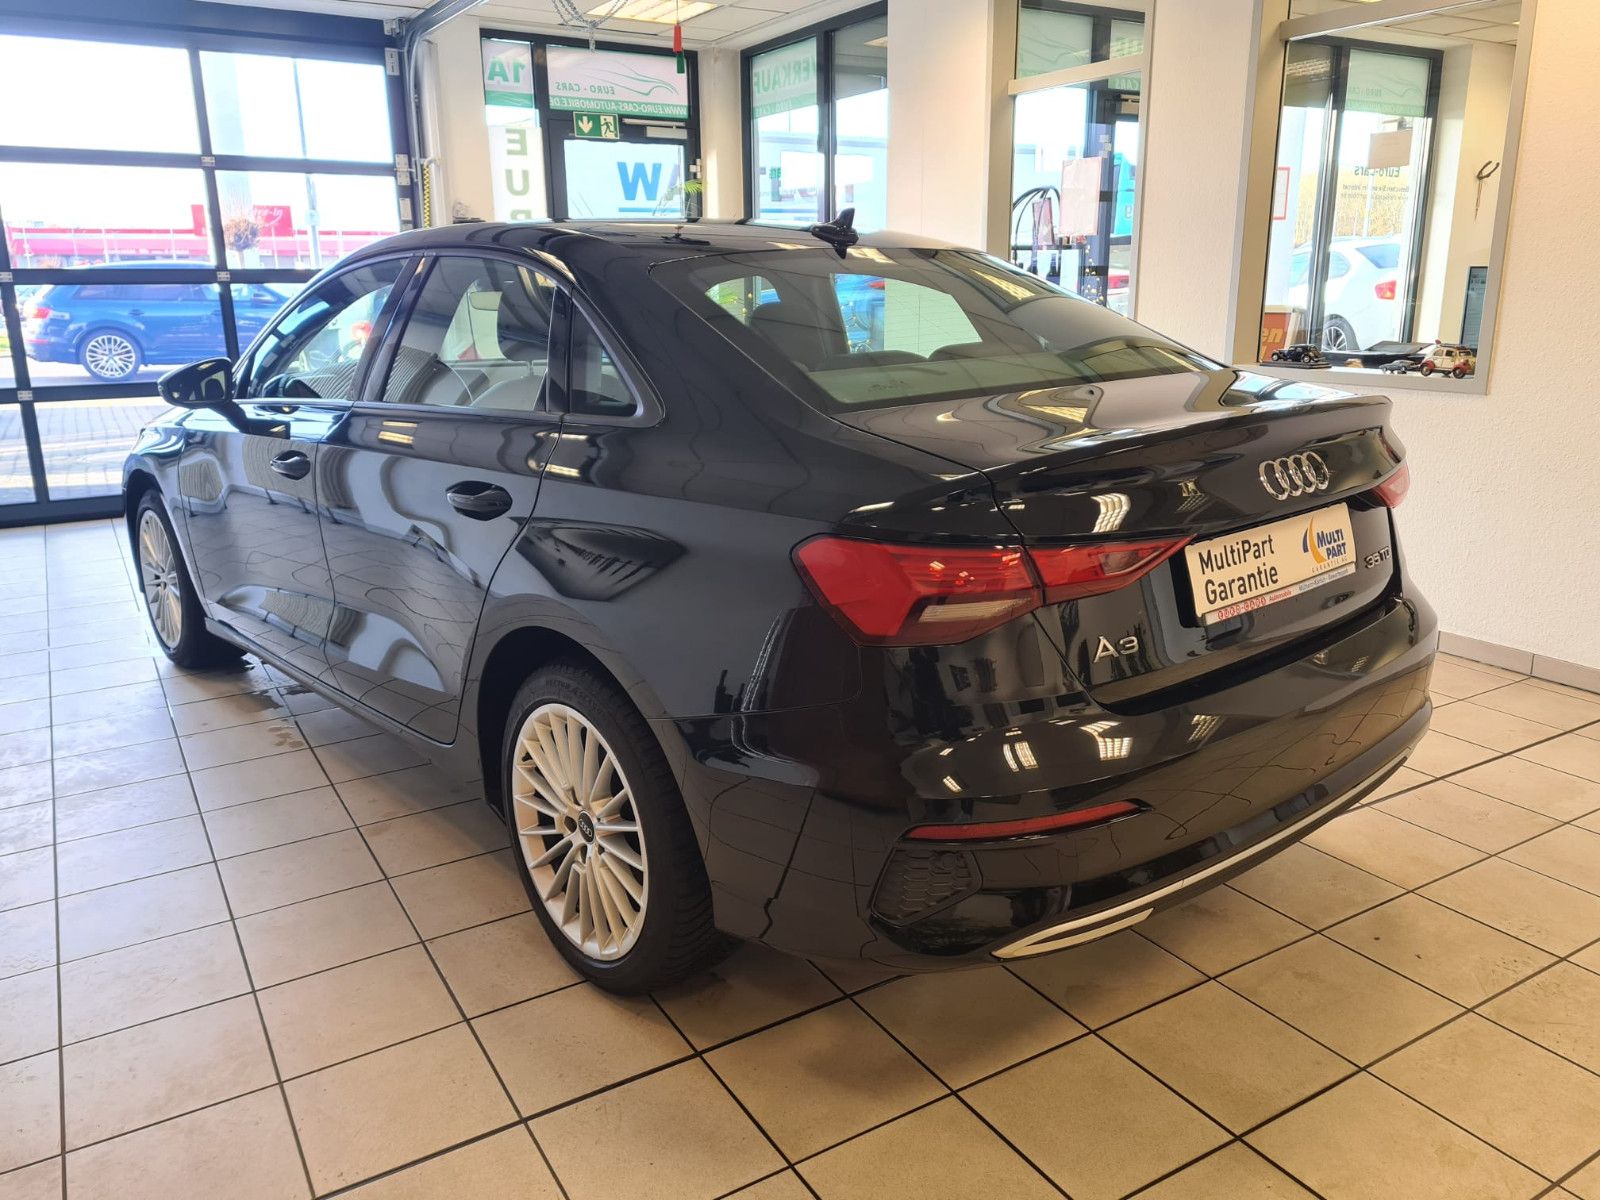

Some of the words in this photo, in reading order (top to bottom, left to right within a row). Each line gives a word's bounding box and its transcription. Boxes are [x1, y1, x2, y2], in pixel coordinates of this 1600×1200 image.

[1316, 528, 1345, 548] MULTI
[1326, 542, 1347, 560] PART
[1198, 534, 1276, 576] MultiPart
[1205, 564, 1279, 605] Garantie
[1093, 635, 1139, 664] A3
